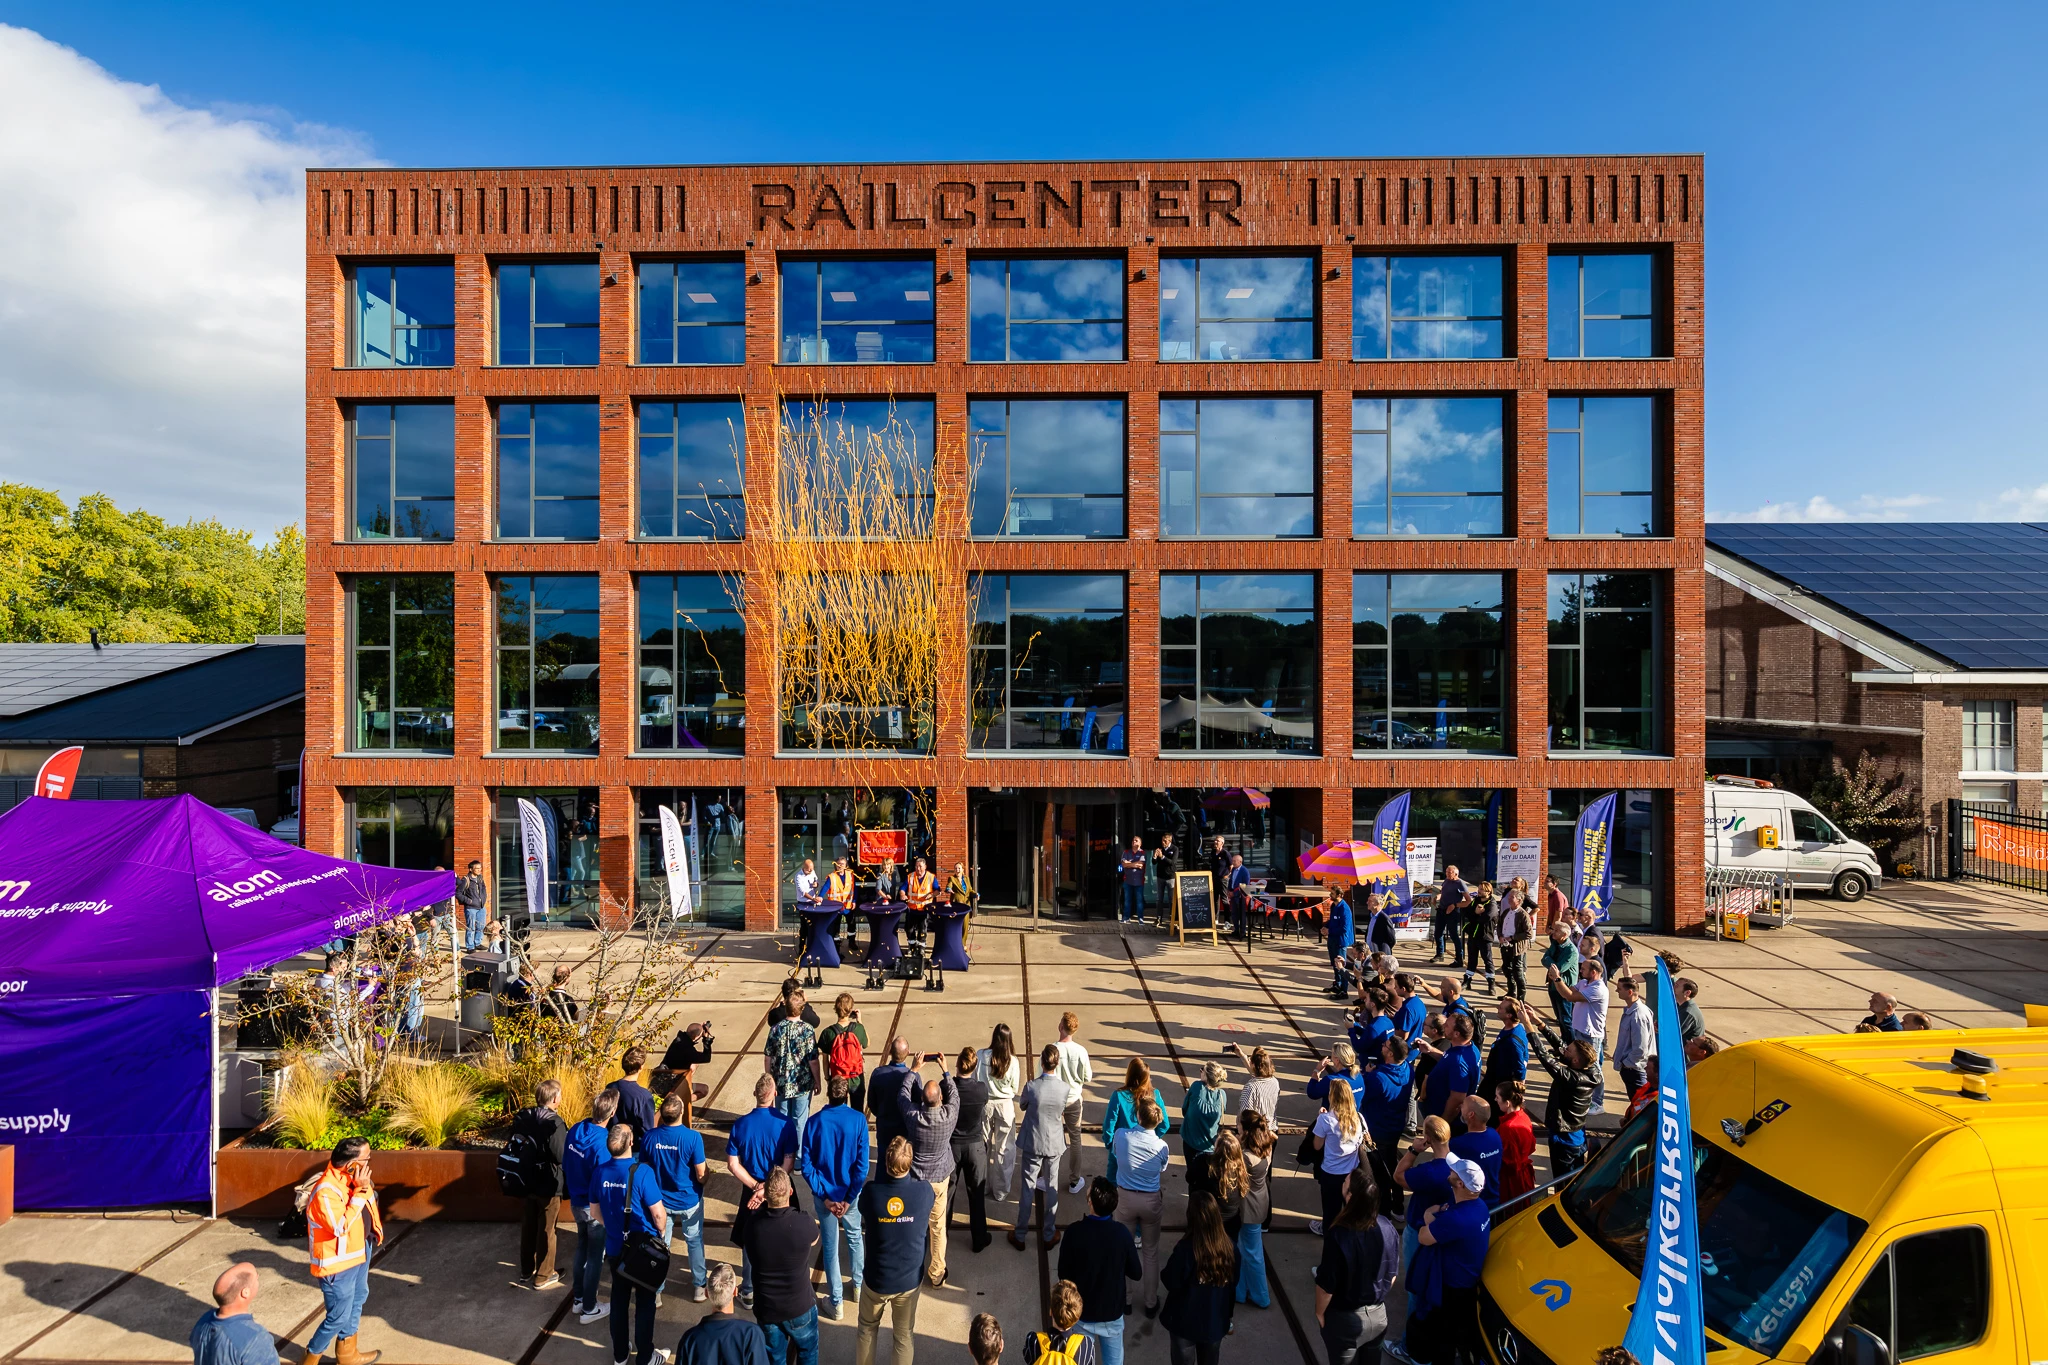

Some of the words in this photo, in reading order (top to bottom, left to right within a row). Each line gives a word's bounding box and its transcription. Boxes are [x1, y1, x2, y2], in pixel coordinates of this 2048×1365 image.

[752, 180, 1242, 230] RAILCENTER
[1393, 821, 1402, 853] SPOOR
[1584, 828, 1592, 848] IETS
[1598, 821, 1607, 853] SPOOR
[1583, 849, 1591, 873] BENT
[1598, 853, 1606, 872] HET
[207, 869, 283, 902] alom
[228, 893, 264, 909] railway
[264, 877, 317, 897] engineering
[322, 866, 349, 879] supply
[1597, 873, 1603, 886] OP
[45, 902, 60, 914] &
[59, 899, 113, 915] supply
[333, 907, 376, 930] alom.eu
[0, 1108, 71, 1134] supply
